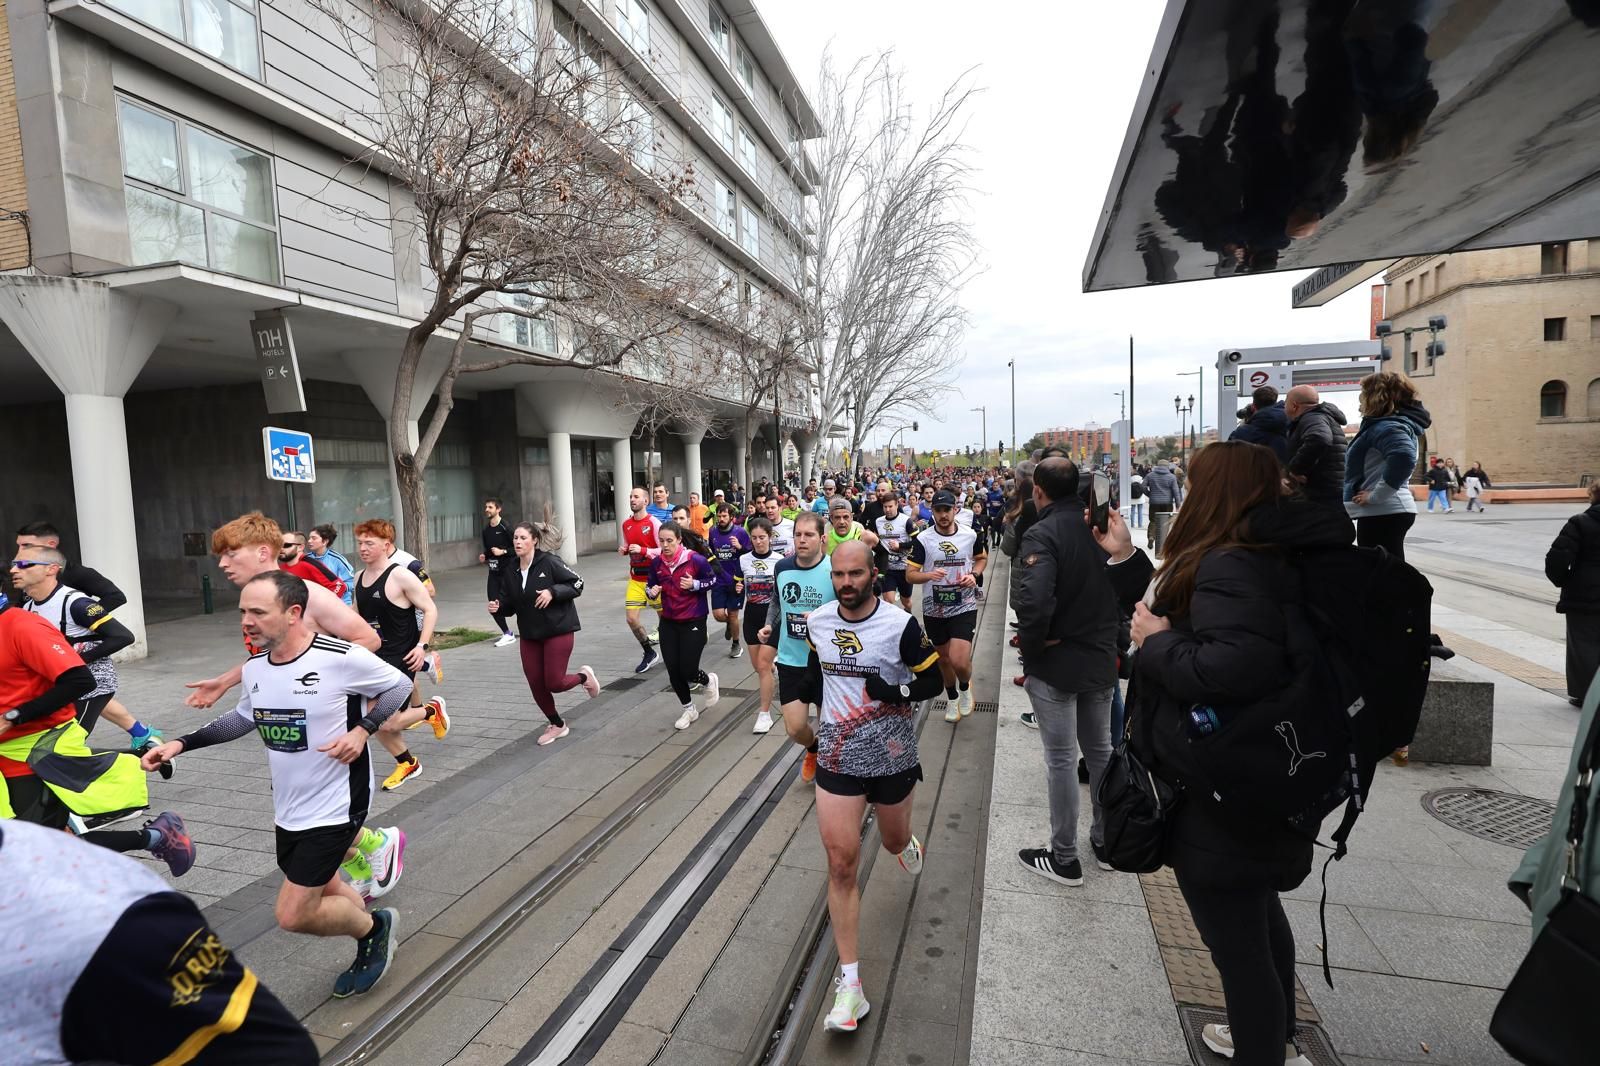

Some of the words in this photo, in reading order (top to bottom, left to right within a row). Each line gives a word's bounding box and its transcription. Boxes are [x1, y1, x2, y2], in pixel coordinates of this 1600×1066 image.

[1293, 278, 1316, 305] PLAZA
[1317, 268, 1331, 290] DEL
[262, 349, 285, 357] HOTELS
[938, 592, 956, 601] 726
[840, 657, 856, 666] XXVII
[835, 664, 852, 672] MEDIA
[852, 666, 880, 675] MARATÓN
[259, 724, 301, 741] 11025
